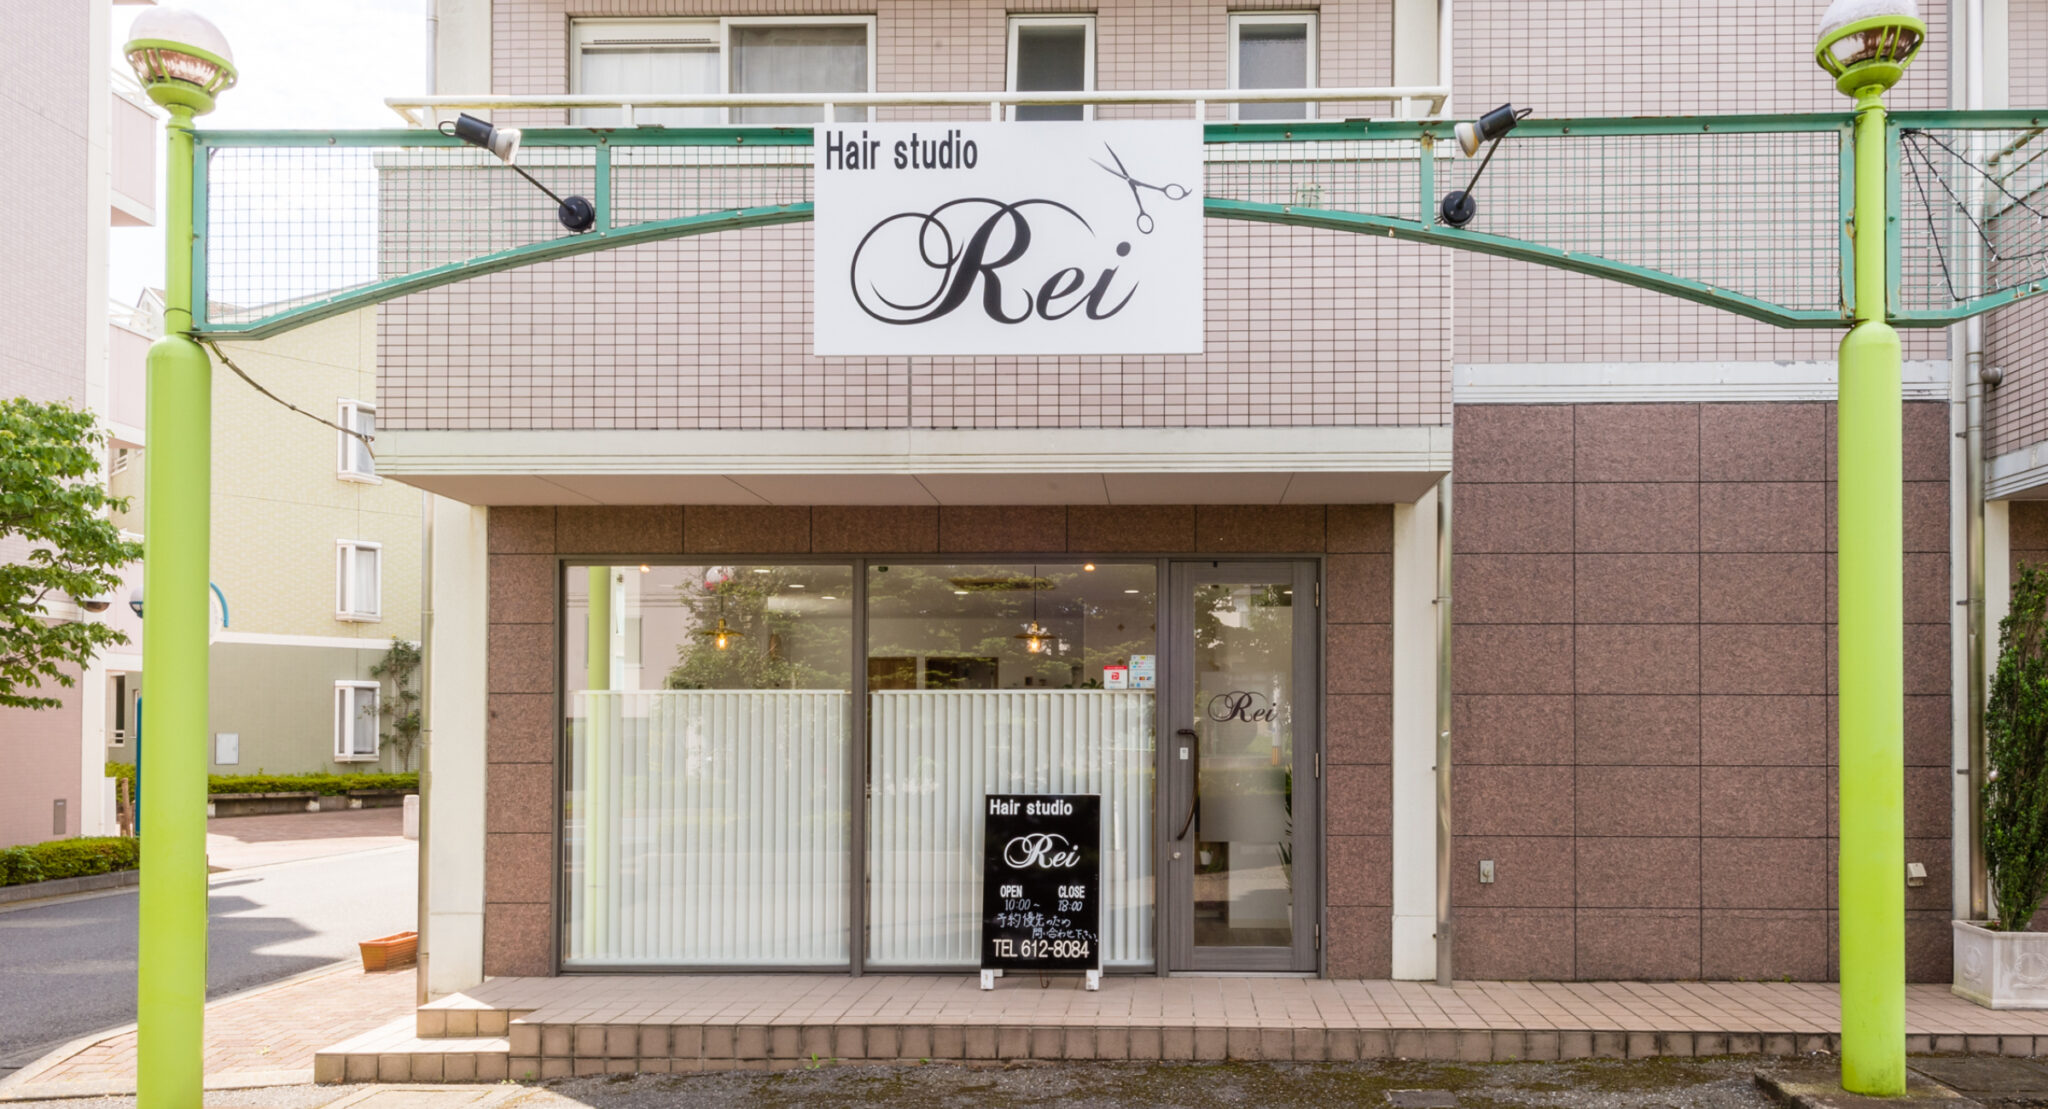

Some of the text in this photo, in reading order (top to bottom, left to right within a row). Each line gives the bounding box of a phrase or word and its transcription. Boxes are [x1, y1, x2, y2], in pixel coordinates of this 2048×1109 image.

[826, 130, 978, 170] Hair studio
[850, 197, 1140, 325] Rei
[1207, 690, 1279, 723] Rei
[990, 799, 1073, 816] Hair studio
[1004, 833, 1080, 869] Rei
[1000, 885, 1022, 898] OPEN
[1058, 885, 1085, 899] CLOSE
[993, 939, 1089, 958] TEL 612-8084
